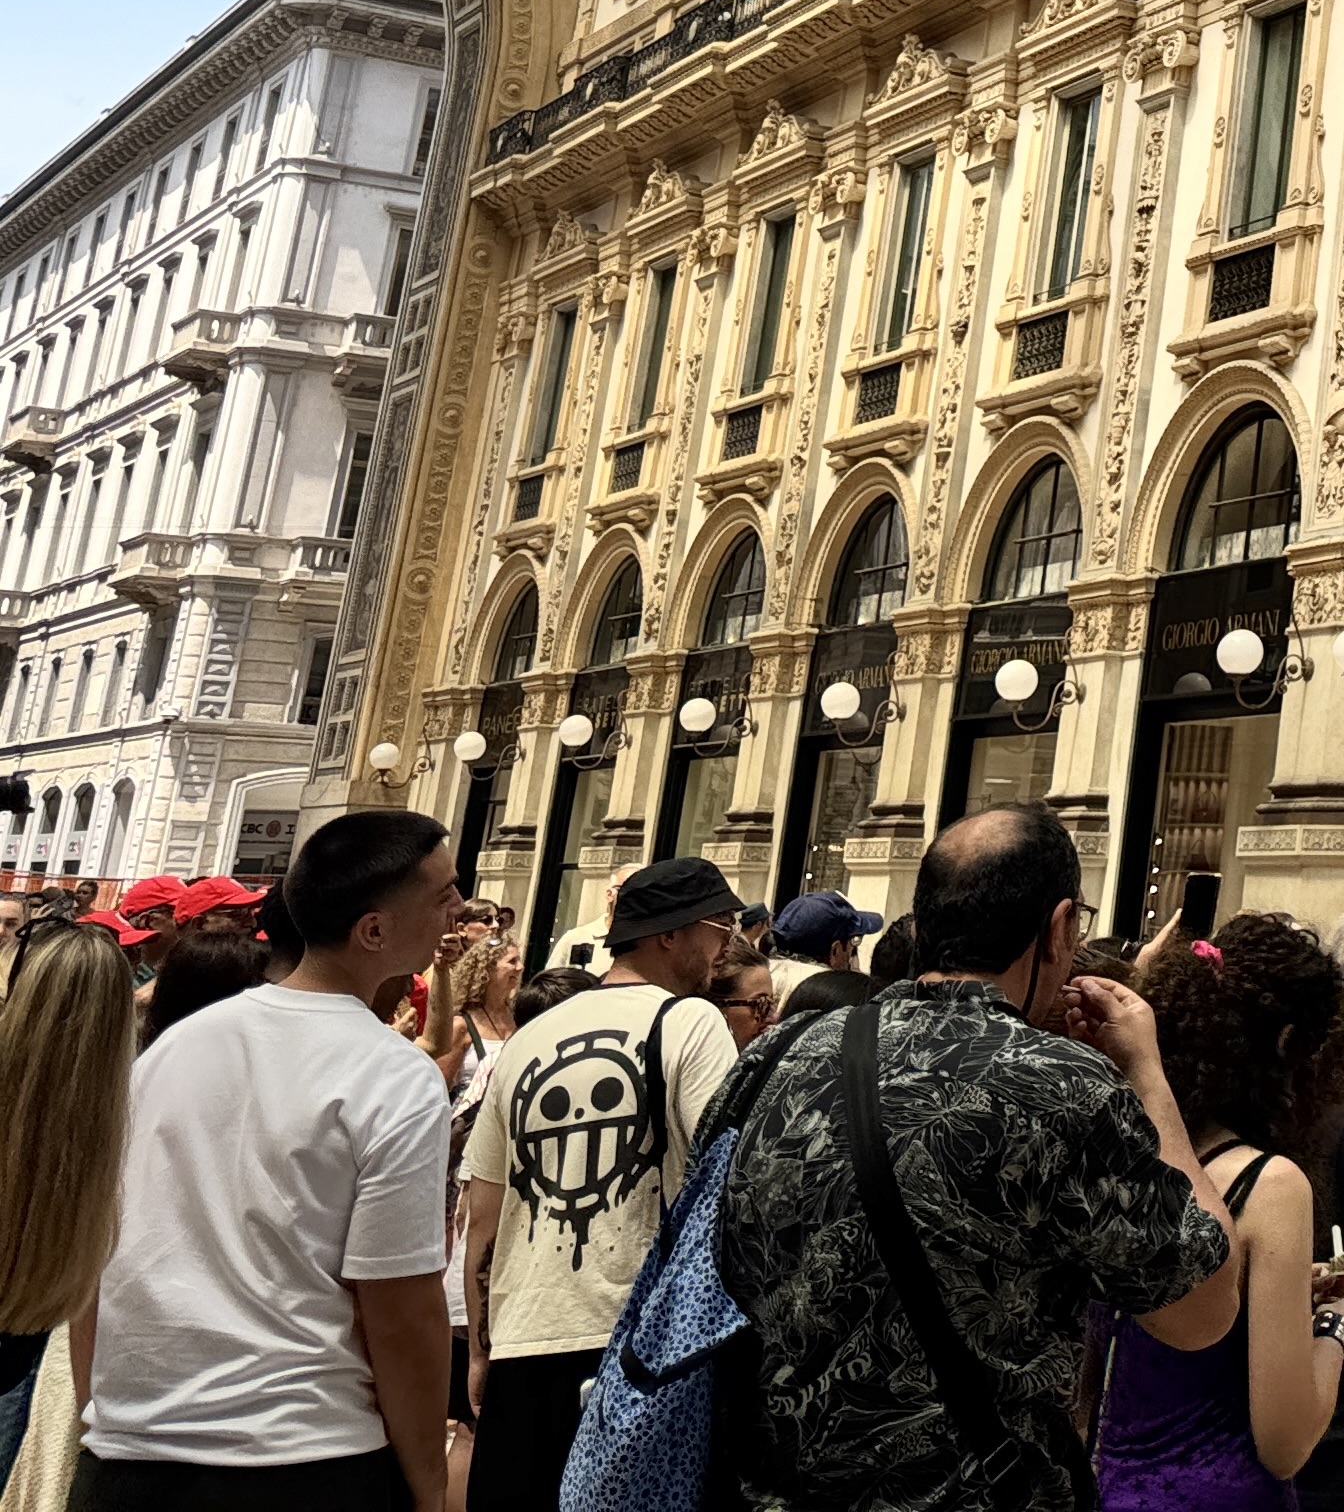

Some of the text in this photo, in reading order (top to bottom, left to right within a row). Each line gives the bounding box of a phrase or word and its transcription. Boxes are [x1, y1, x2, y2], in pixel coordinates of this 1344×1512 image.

[1162, 609, 1280, 651] GIORGIO ARMANI
[1022, 641, 1065, 666] ARMAN
[857, 665, 894, 689] ARMAN
